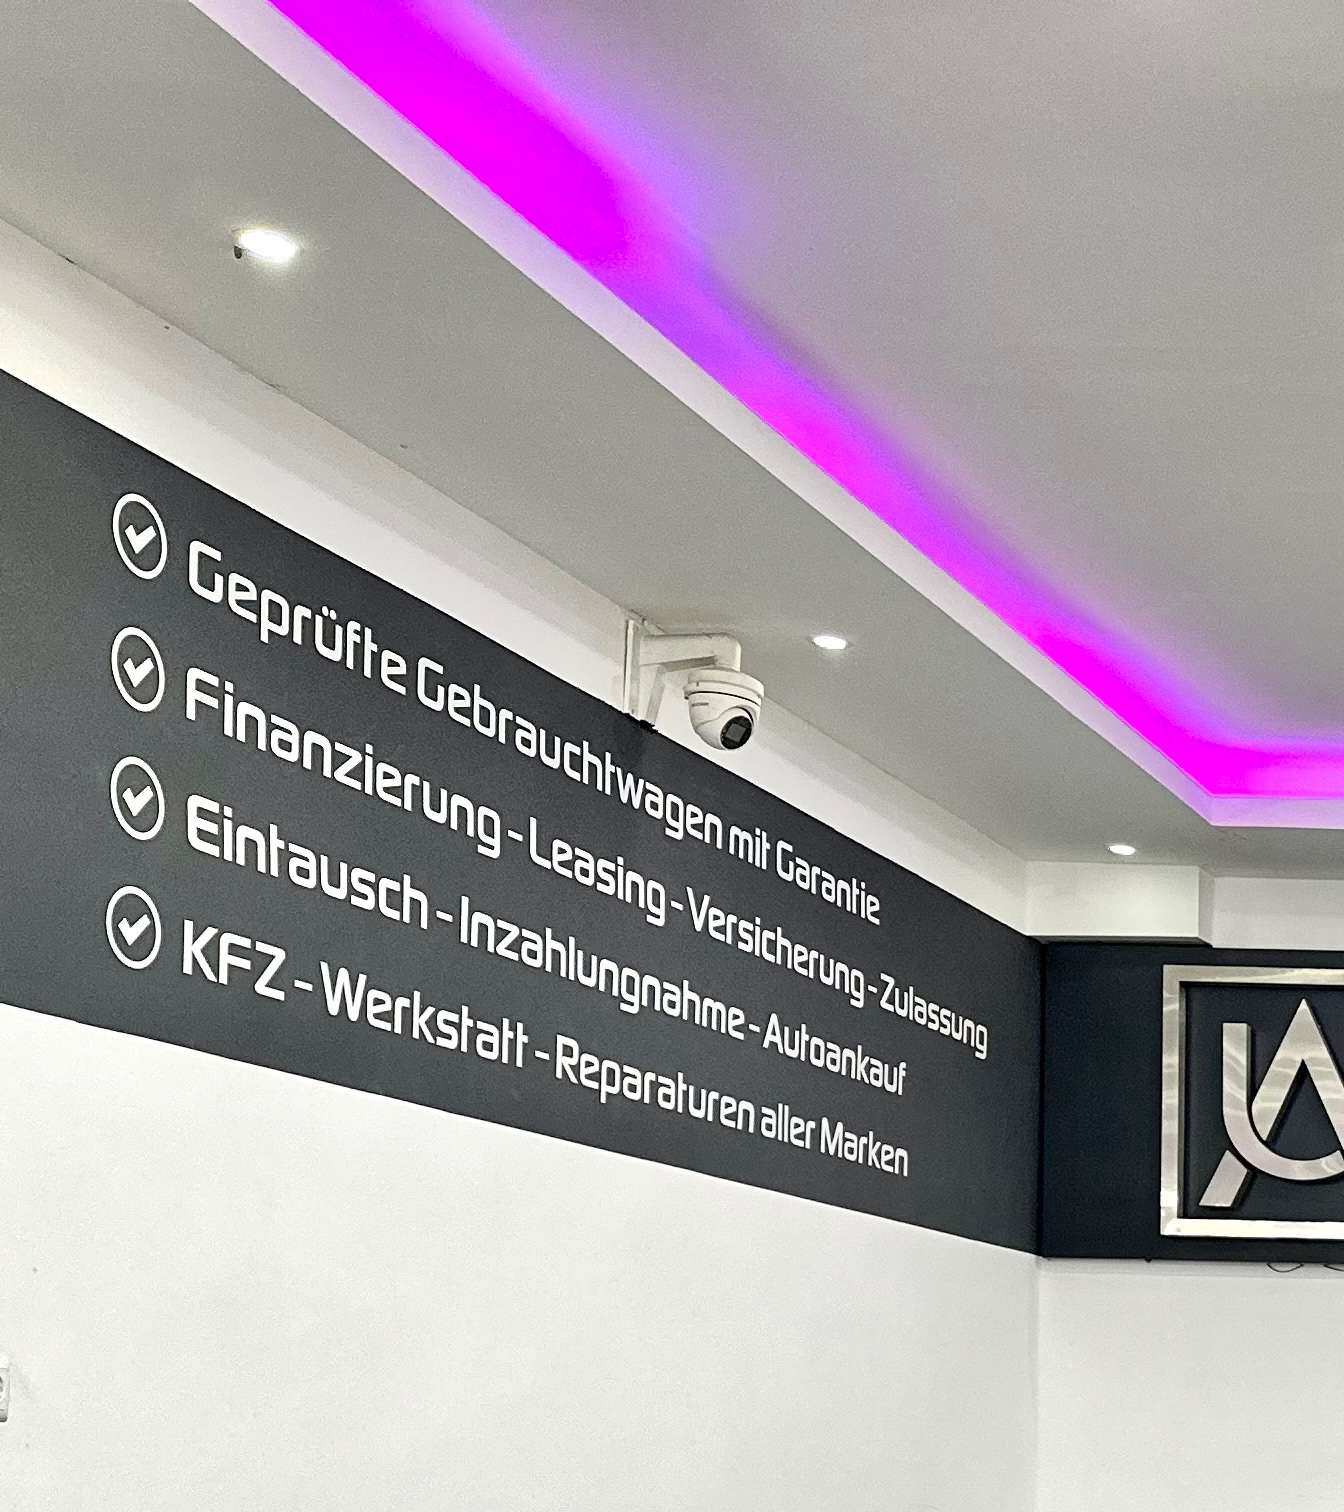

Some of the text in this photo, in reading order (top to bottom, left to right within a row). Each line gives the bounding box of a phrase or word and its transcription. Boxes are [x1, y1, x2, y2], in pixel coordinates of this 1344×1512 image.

[186, 667, 501, 858] Finanzierung
[529, 816, 666, 926] Leasing
[686, 886, 865, 1007] Versicherung
[879, 973, 988, 1060] Zulassung
[188, 541, 881, 925] Geprüfte Gebrauchtwagen mit Garantie
[182, 919, 286, 1000] KFZ
[319, 960, 529, 1067] Werkstatt
[555, 1034, 755, 1134] Reparaturen
[760, 1104, 816, 1150] aller
[820, 1116, 908, 1177] Marken
[186, 794, 428, 929] Eintausch
[460, 895, 745, 1040] Inzahlungnahme
[762, 1013, 907, 1096] Autoankauf
